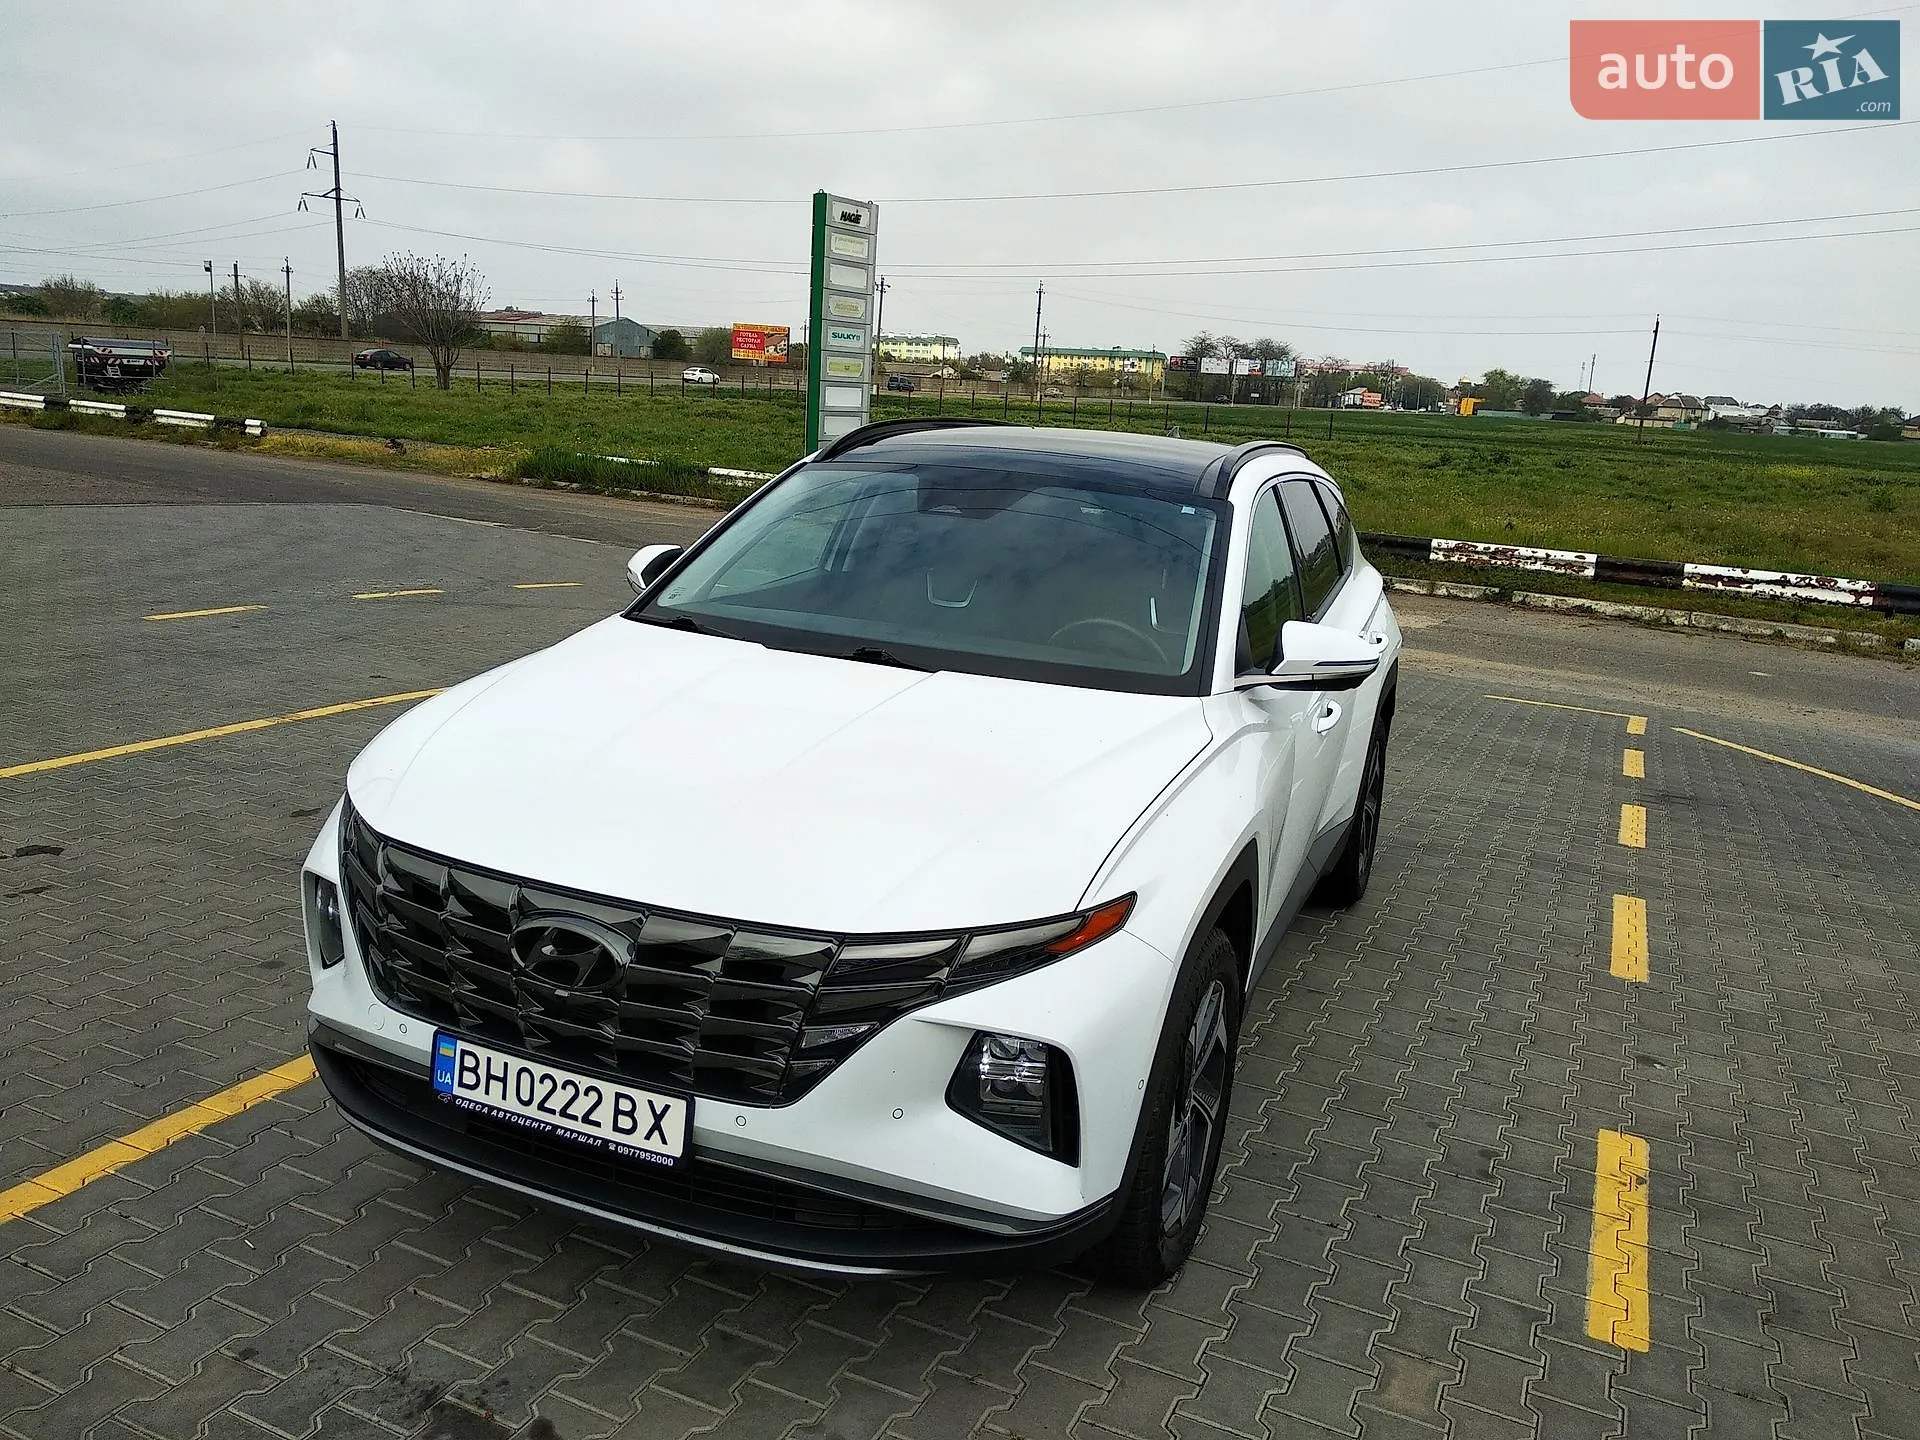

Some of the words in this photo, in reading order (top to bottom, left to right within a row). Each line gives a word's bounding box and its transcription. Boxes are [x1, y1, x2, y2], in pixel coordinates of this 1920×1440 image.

[831, 332, 857, 340] SULKY
[437, 1069, 452, 1086] UA
[490, 1109, 552, 1133] АВТОЦЕНТР
[555, 1128, 603, 1147] МАРШАЛ
[617, 1145, 674, 1168] 0977952000
